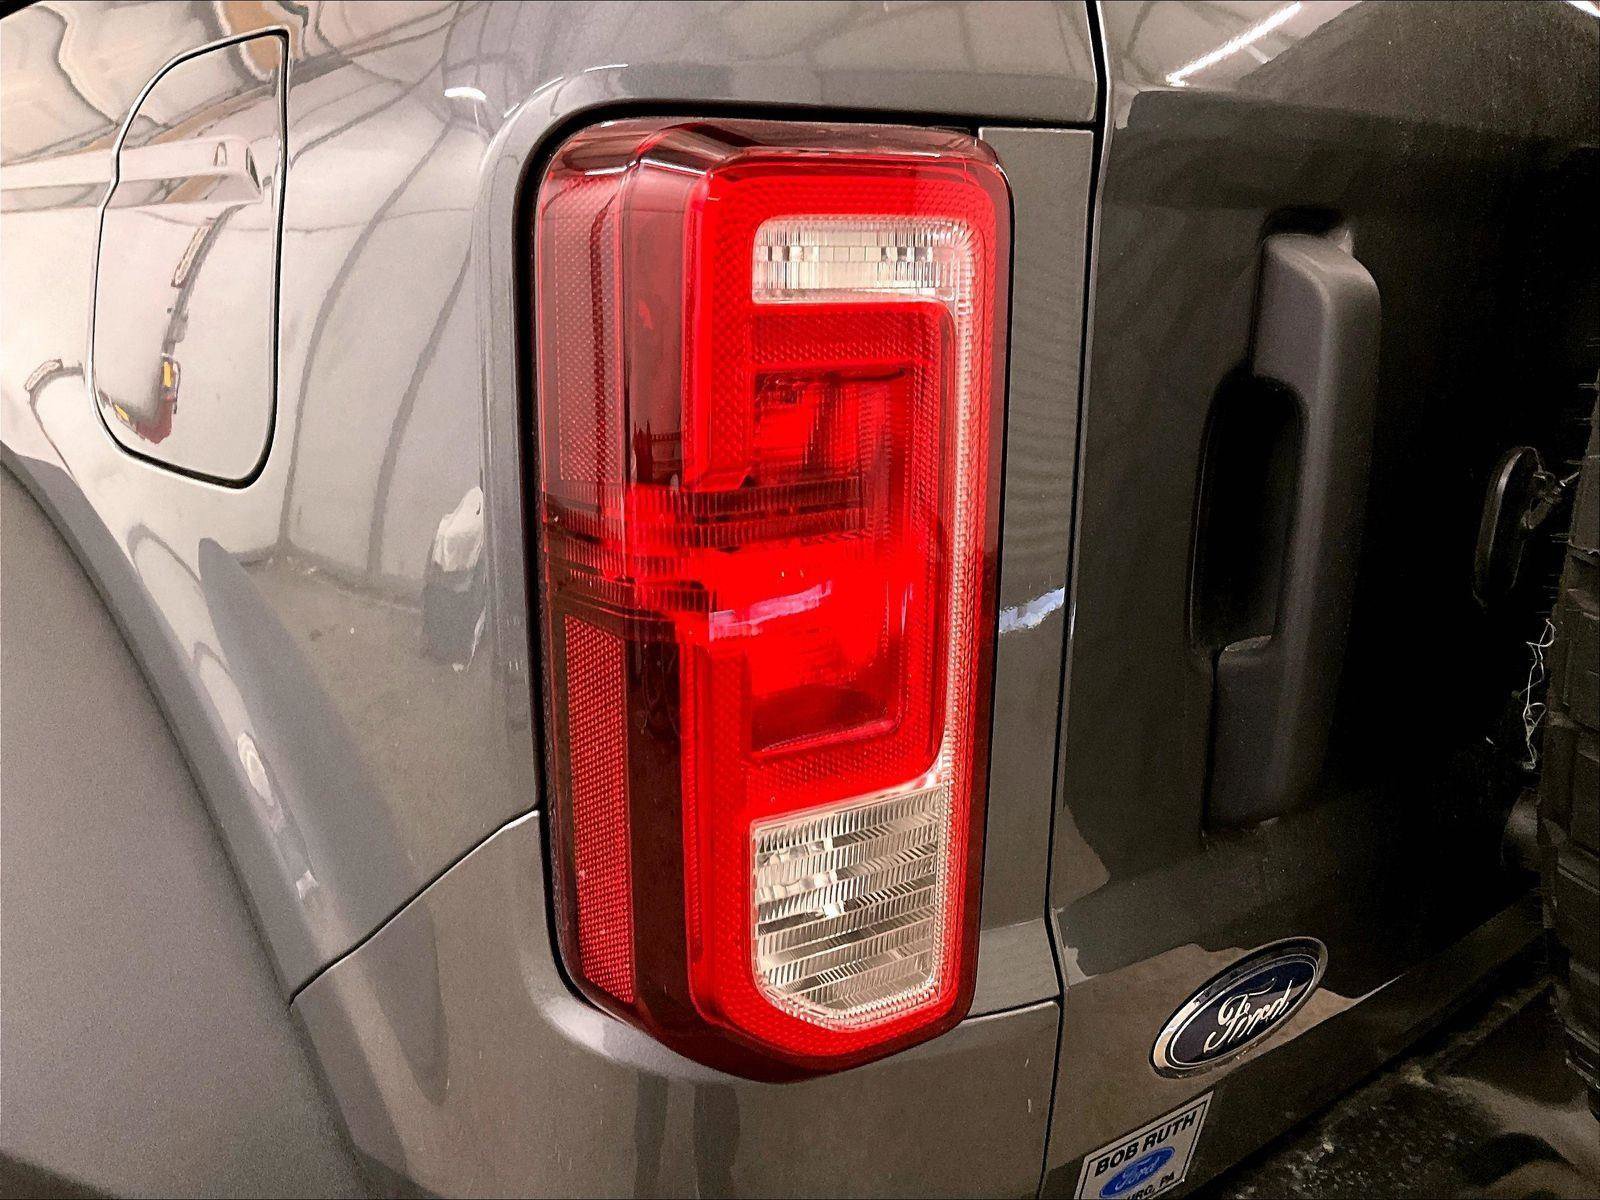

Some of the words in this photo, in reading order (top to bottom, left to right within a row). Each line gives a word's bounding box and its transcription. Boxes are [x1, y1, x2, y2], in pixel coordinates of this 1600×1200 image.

[1204, 977, 1293, 1053] Ford
[1095, 1142, 1139, 1178] BOB
[1142, 1110, 1197, 1152] RUTH
[1114, 1155, 1161, 1191] Ford
[1160, 1171, 1175, 1188] PA
